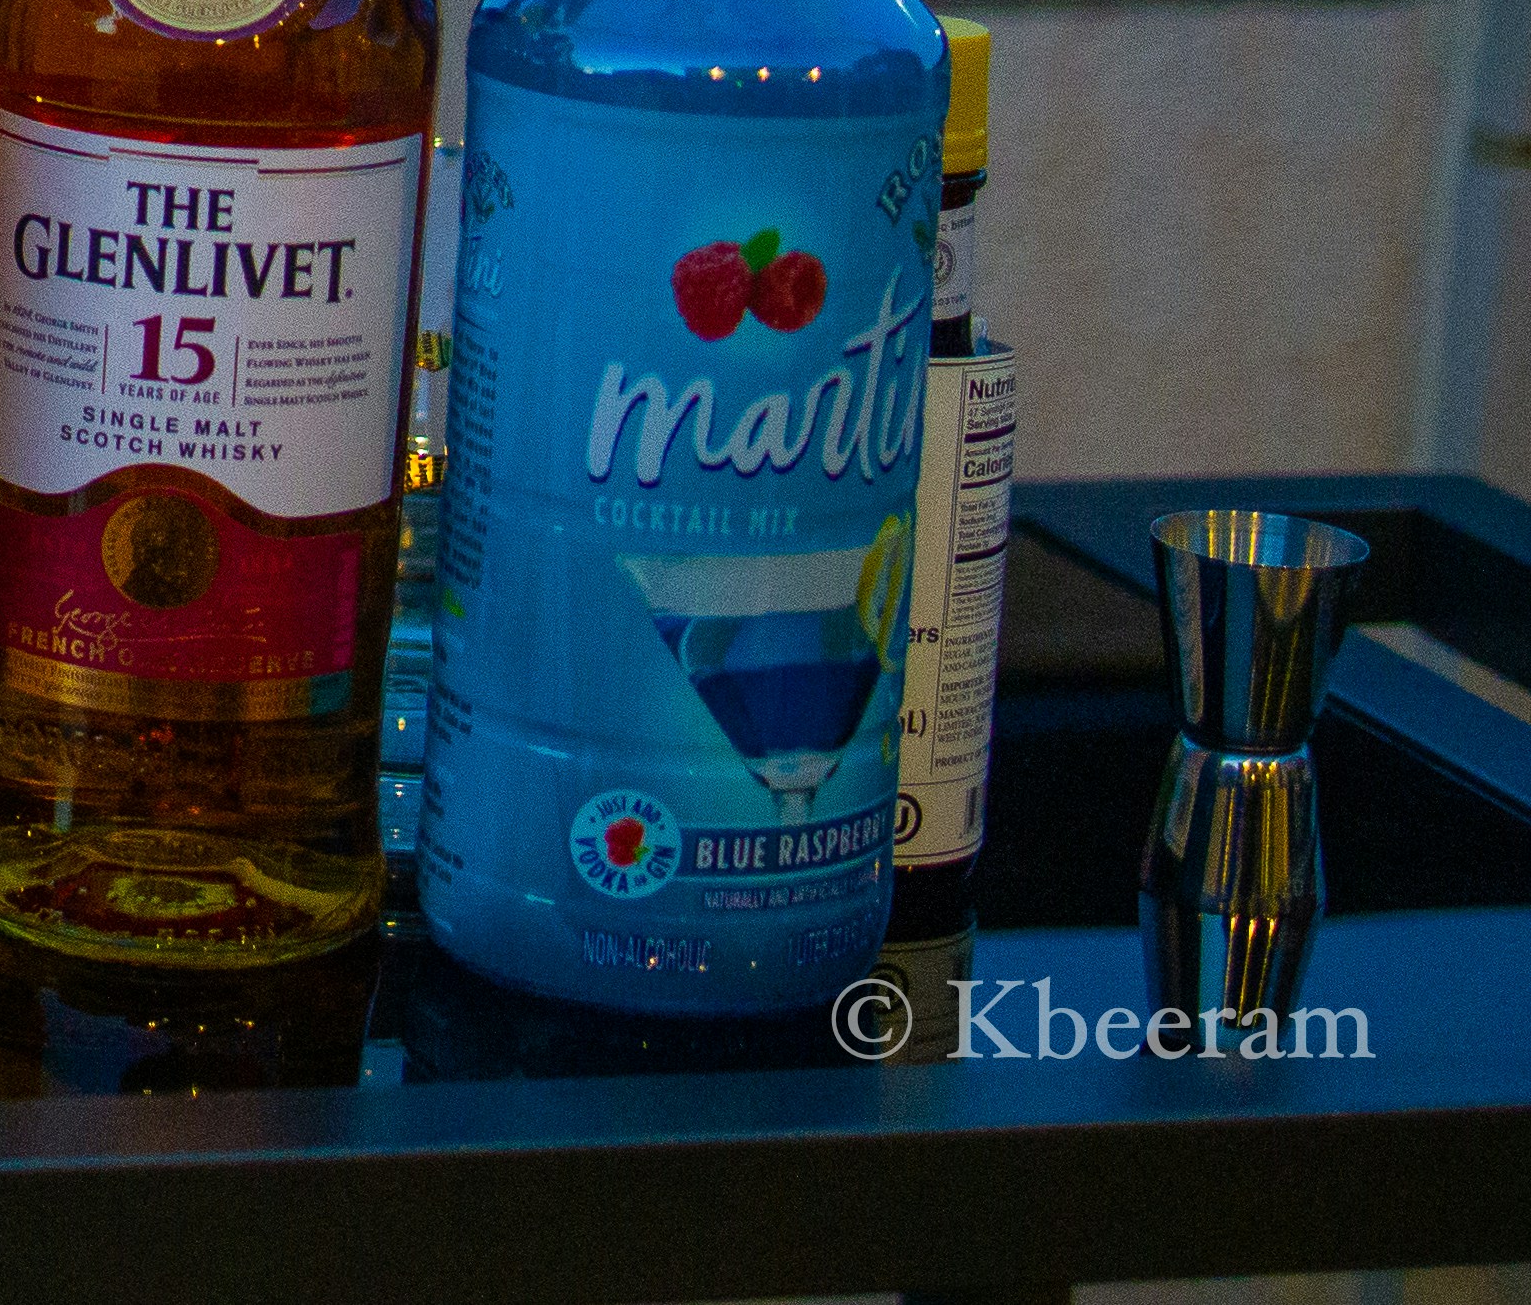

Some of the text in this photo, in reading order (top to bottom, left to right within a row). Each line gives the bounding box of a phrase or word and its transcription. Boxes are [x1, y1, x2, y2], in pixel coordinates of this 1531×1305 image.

[127, 181, 235, 232] THE
[130, 315, 215, 385] 15
[120, 382, 220, 405] YEARS OF AGE
[82, 406, 264, 439] SINGLE MALT
[61, 425, 284, 462] SCOTCH WHISKY
[593, 495, 799, 536] COCKTAIL MIX
[7, 621, 107, 664] FRENCH
[596, 795, 662, 824] JUST ADD
[575, 837, 676, 894] VODKA GIN
[695, 835, 767, 870] BLUE
[583, 930, 712, 972] NON-ALCOHOLIC
